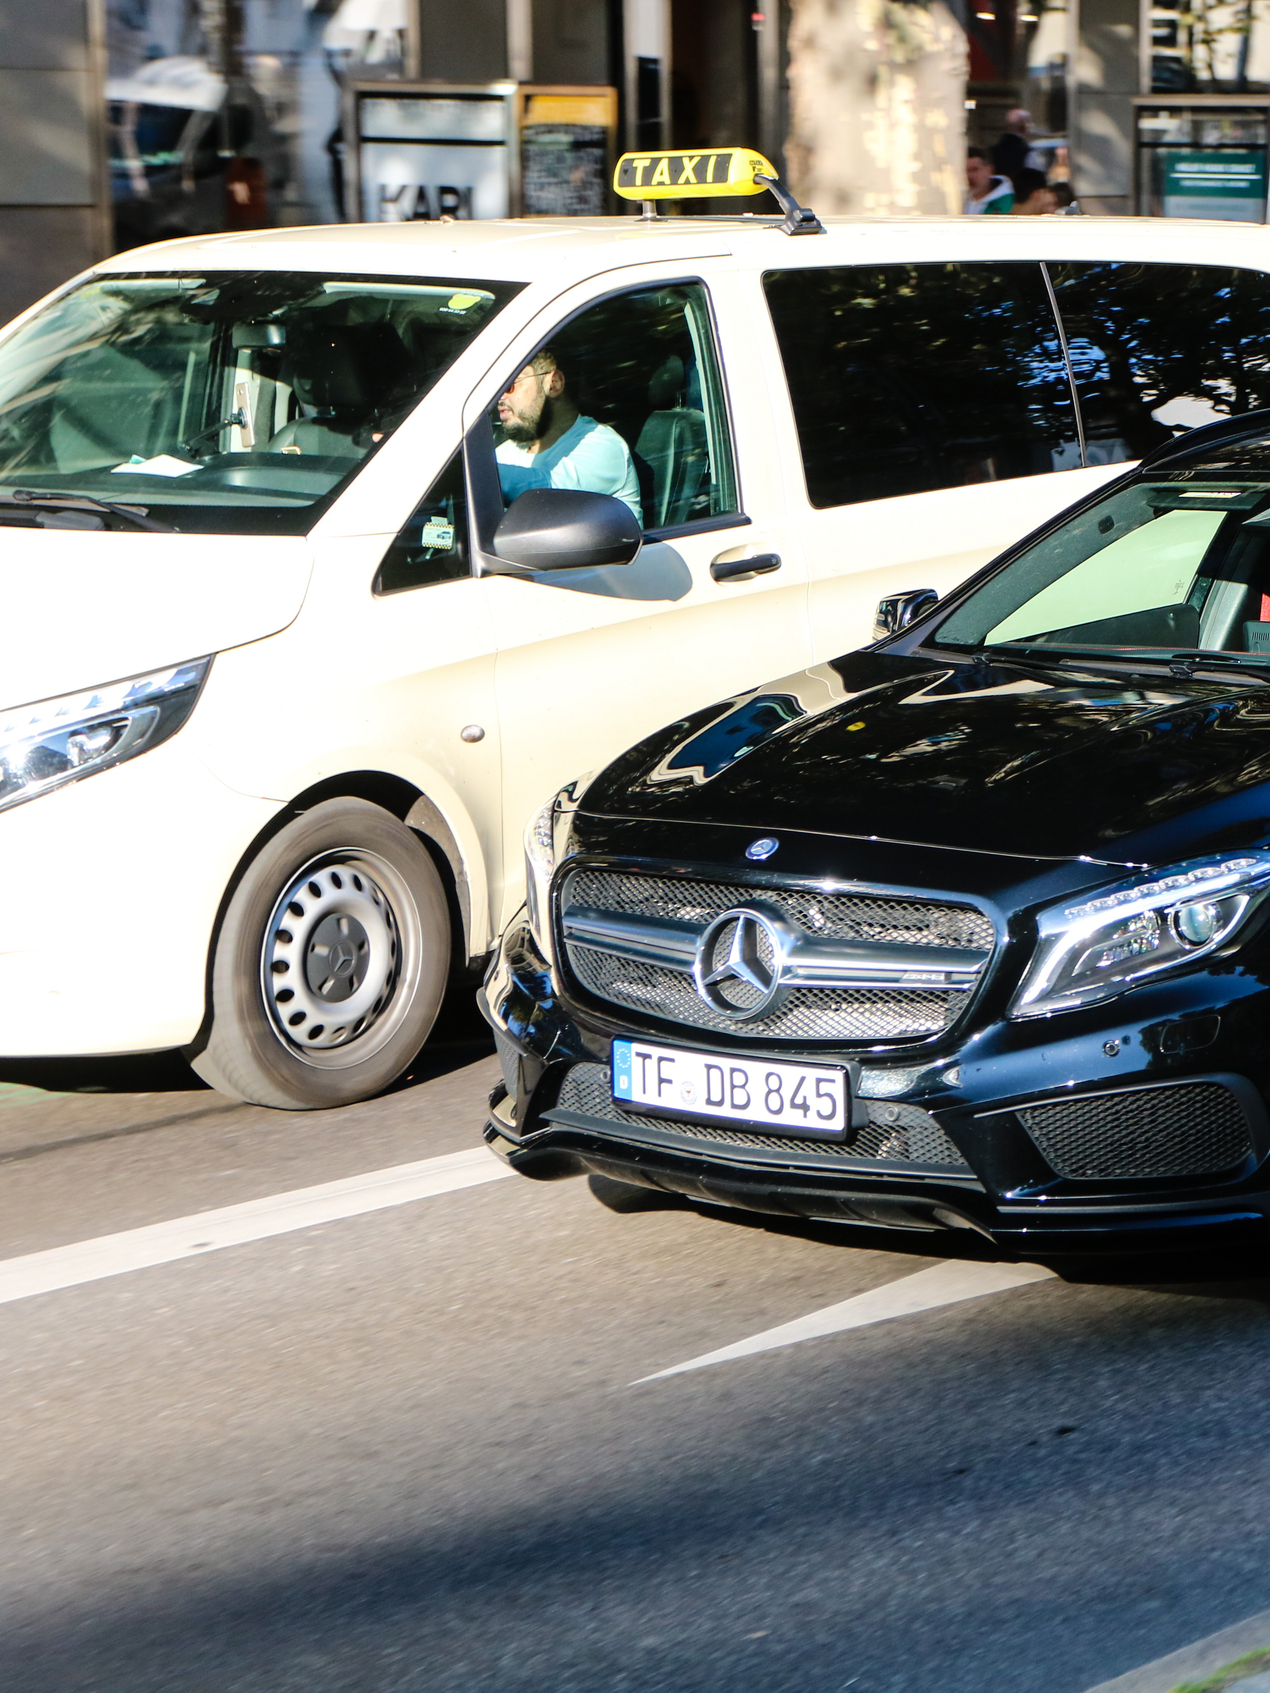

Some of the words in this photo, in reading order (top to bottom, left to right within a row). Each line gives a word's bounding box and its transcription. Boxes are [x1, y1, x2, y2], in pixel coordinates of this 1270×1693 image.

[632, 155, 717, 186] TAXI
[619, 1075, 629, 1090] D
[635, 1051, 676, 1098] TF
[704, 1063, 751, 1111] DB
[764, 1071, 837, 1121] 845
